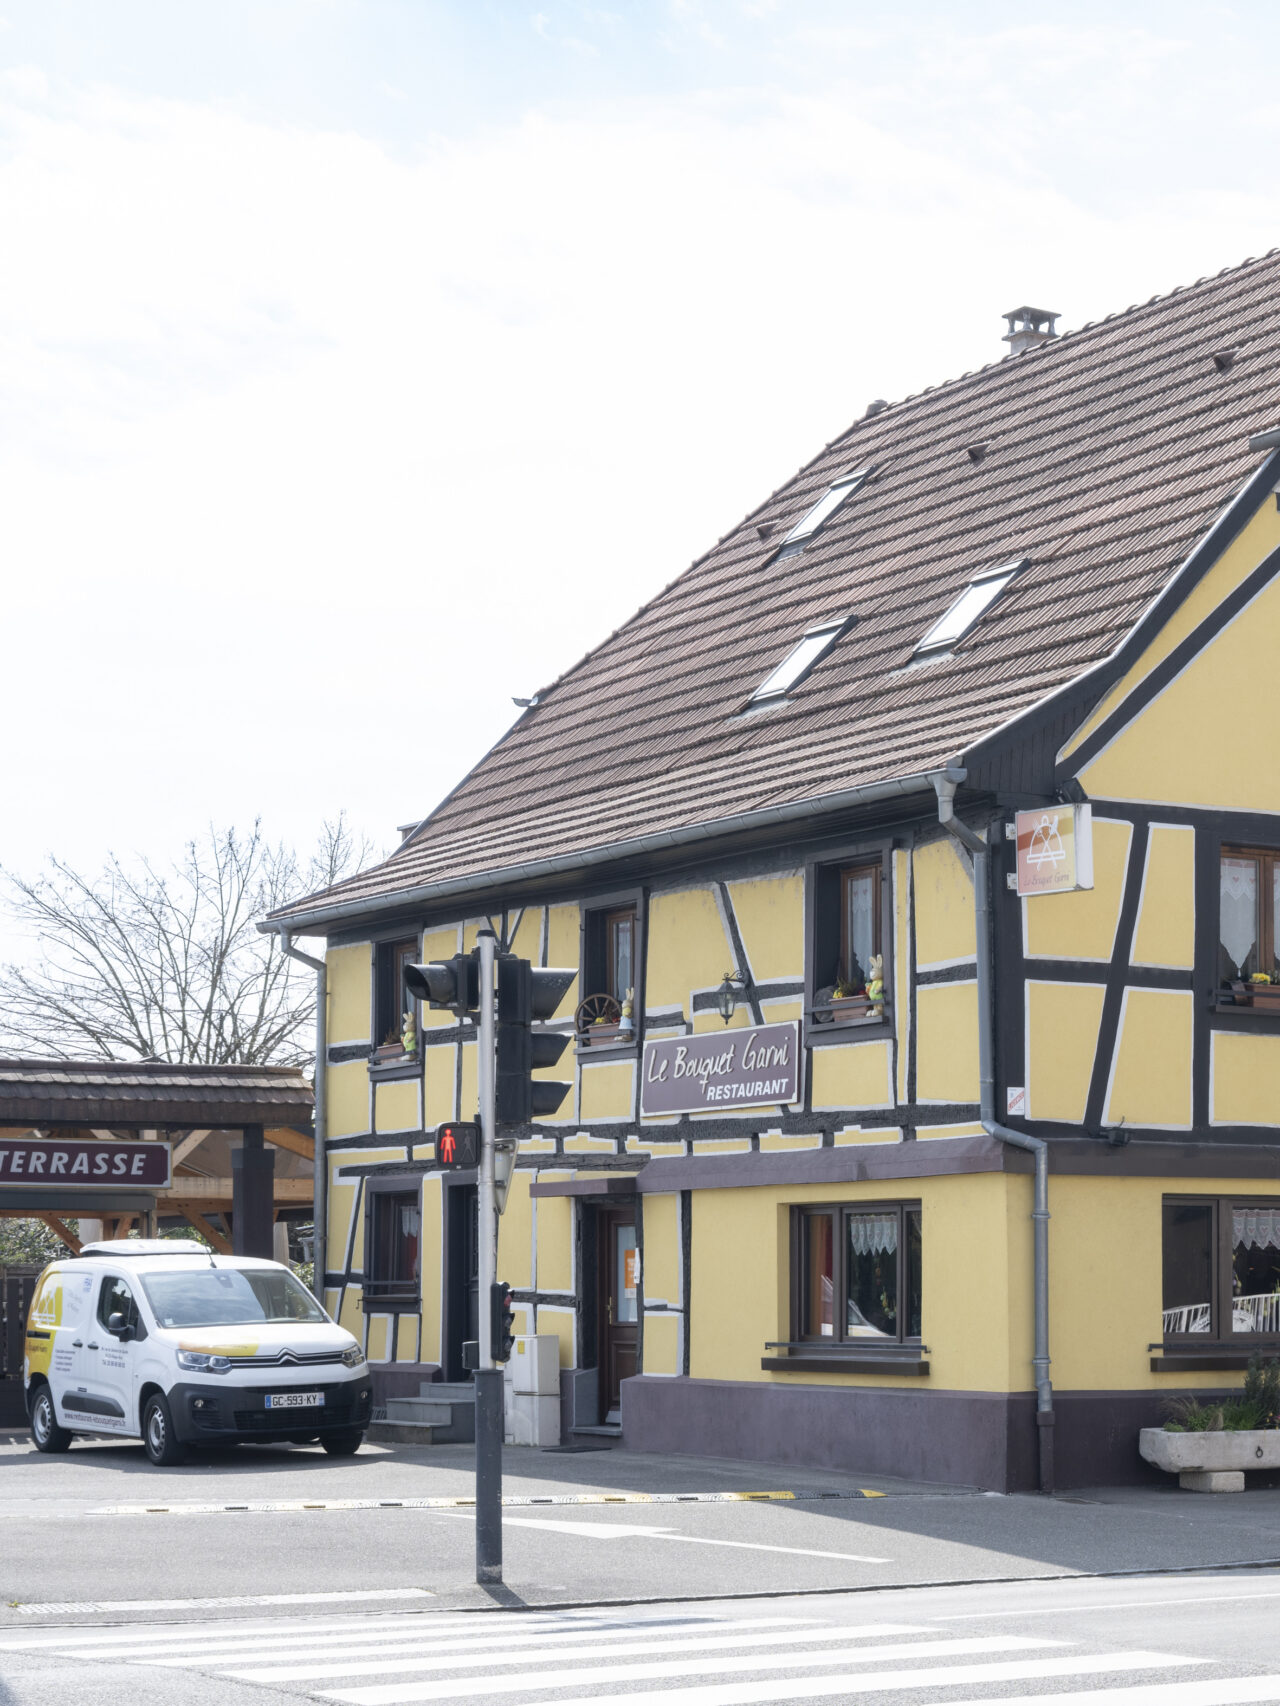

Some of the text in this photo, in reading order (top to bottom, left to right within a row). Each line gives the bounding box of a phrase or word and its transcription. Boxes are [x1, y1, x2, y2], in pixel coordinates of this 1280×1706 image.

[647, 1032, 790, 1094] Le Bouquet Garni
[706, 1078, 789, 1101] RESTAURANT
[272, 1394, 318, 1407] GC-593-KY
